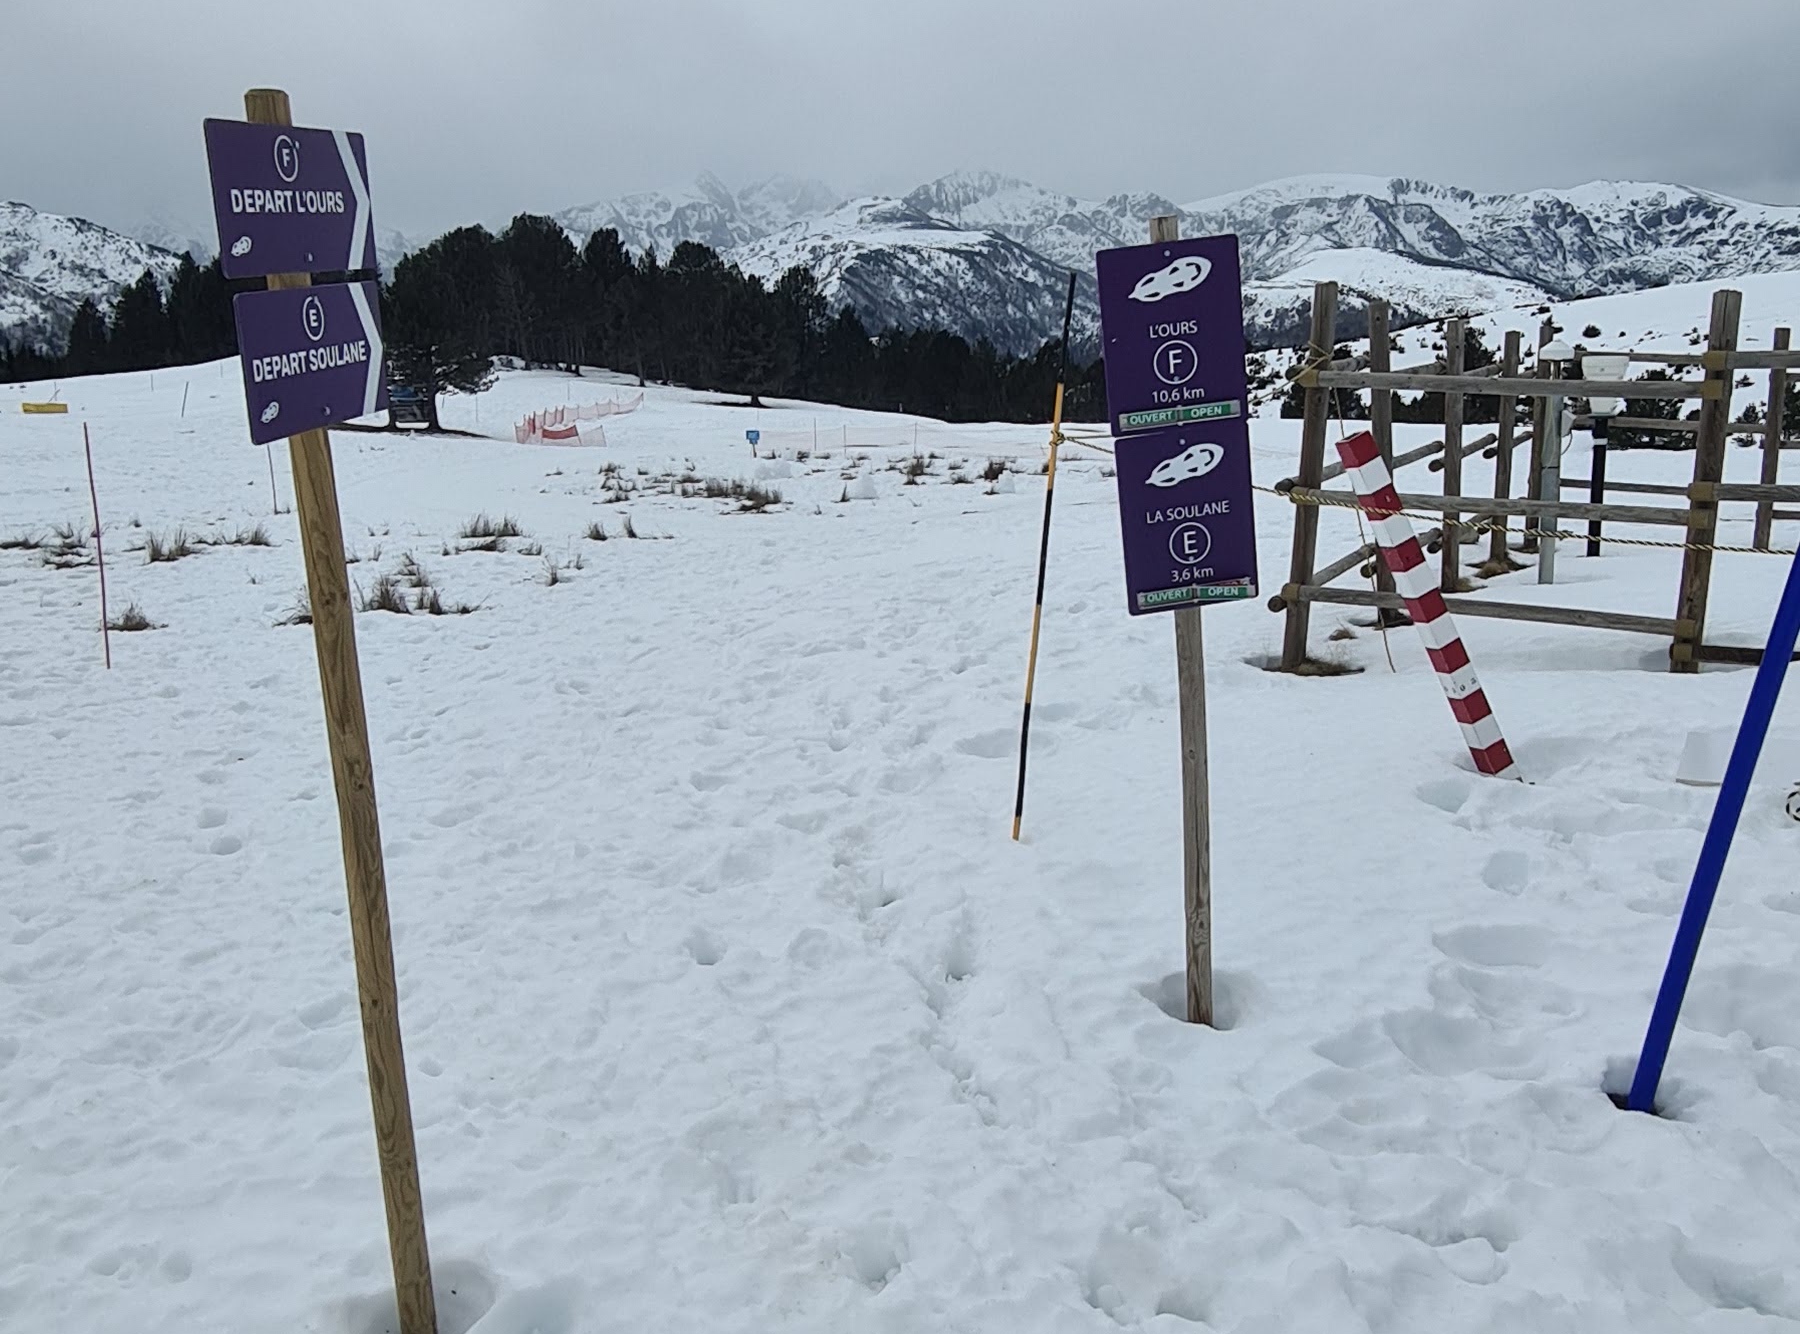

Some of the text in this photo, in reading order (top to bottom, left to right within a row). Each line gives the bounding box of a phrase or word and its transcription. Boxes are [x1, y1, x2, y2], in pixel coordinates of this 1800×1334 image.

[282, 148, 291, 167] F
[231, 189, 345, 214] DEPART L'OURS
[309, 309, 318, 327] E
[1150, 320, 1197, 338] L'OURS
[253, 340, 367, 383] DEPART SOULANE
[1168, 349, 1182, 374] F
[1152, 387, 1205, 404] 10,6 km
[1129, 406, 1222, 425] OUVERT OPEN
[1146, 500, 1230, 524] LA SOULANE
[1183, 531, 1198, 555] E
[1171, 566, 1214, 582] 3,6 km
[1146, 585, 1239, 603] OUVERT OPEN
